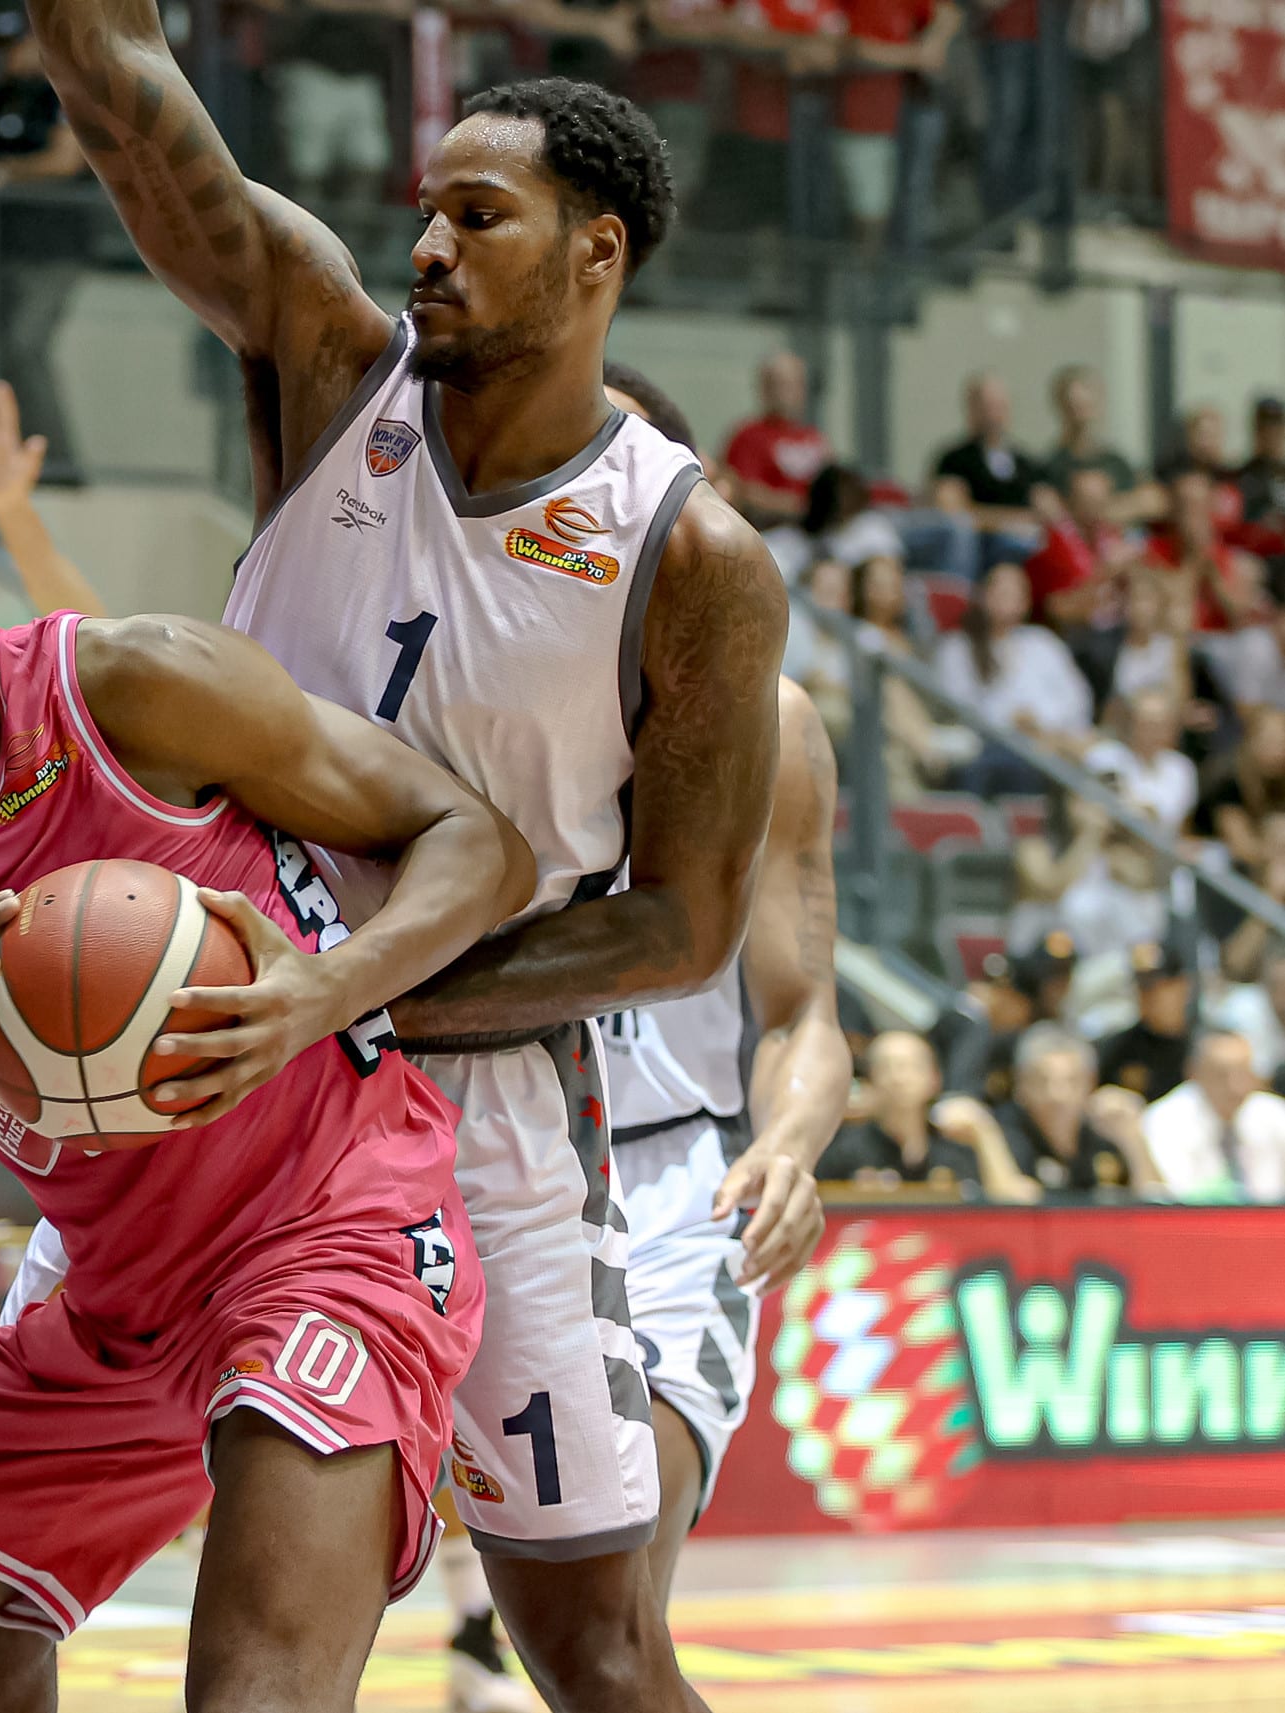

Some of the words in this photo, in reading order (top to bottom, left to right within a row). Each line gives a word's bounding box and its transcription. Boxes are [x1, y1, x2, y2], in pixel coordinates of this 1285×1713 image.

[336, 489, 388, 525] Reebok
[517, 537, 586, 572] Winner
[562, 551, 588, 563] ליגת
[587, 562, 604, 579] סל
[375, 610, 439, 723] 1
[2, 767, 58, 815] Winner
[274, 1311, 369, 1406] 0
[502, 1391, 562, 1506] 1
